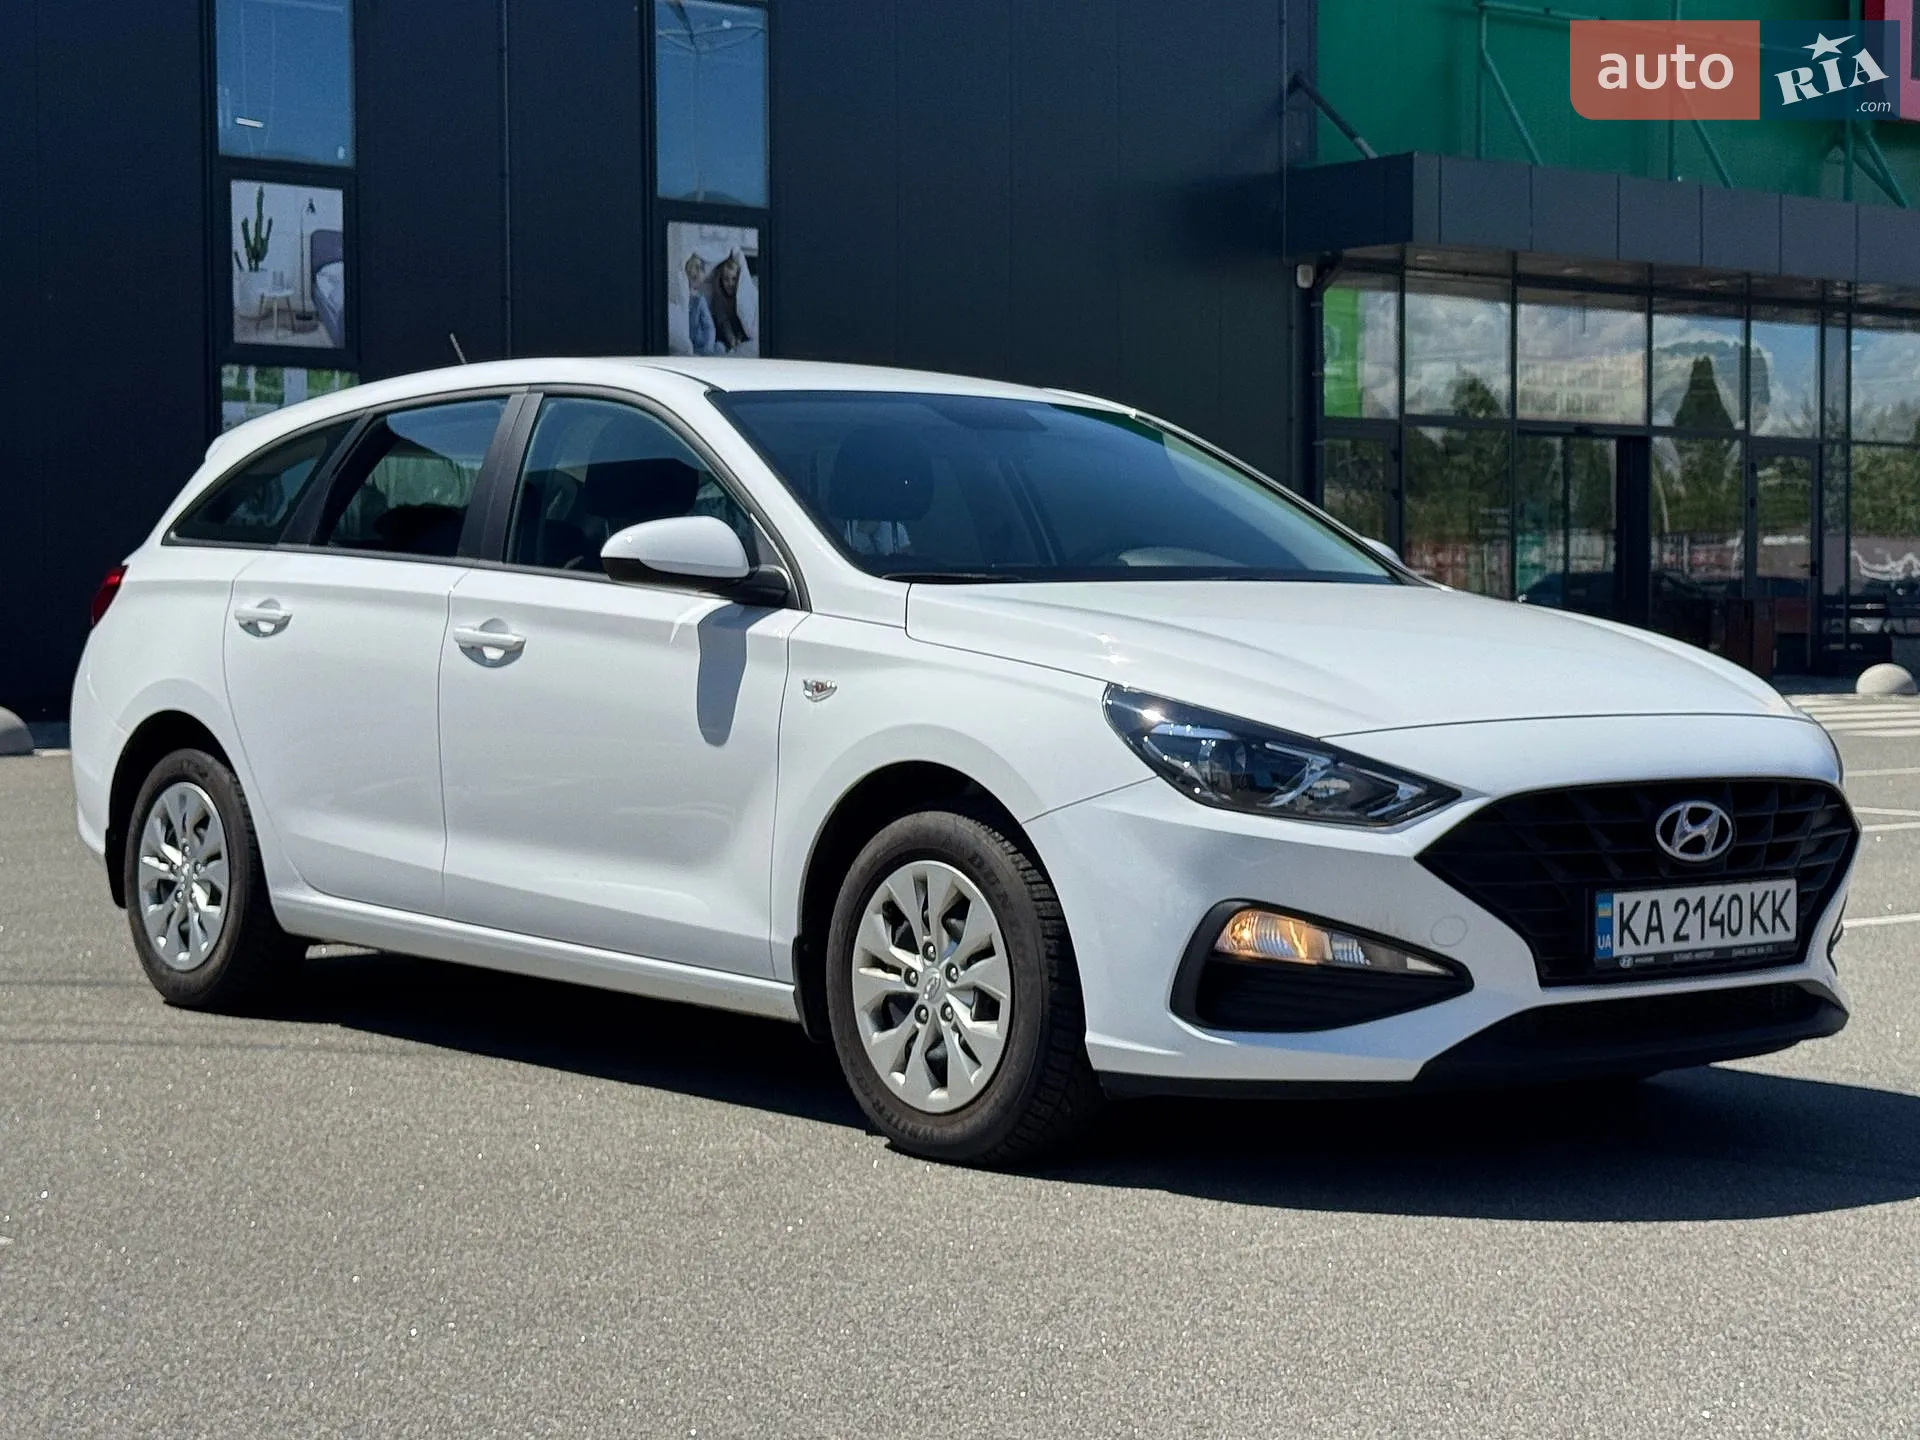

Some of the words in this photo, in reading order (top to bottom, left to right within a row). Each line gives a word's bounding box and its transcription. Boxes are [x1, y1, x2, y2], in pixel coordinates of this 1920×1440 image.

[1618, 899, 1665, 949] KA
[1672, 893, 1744, 943] 2140
[1750, 887, 1792, 937] KK
[1597, 937, 1612, 950] UA
